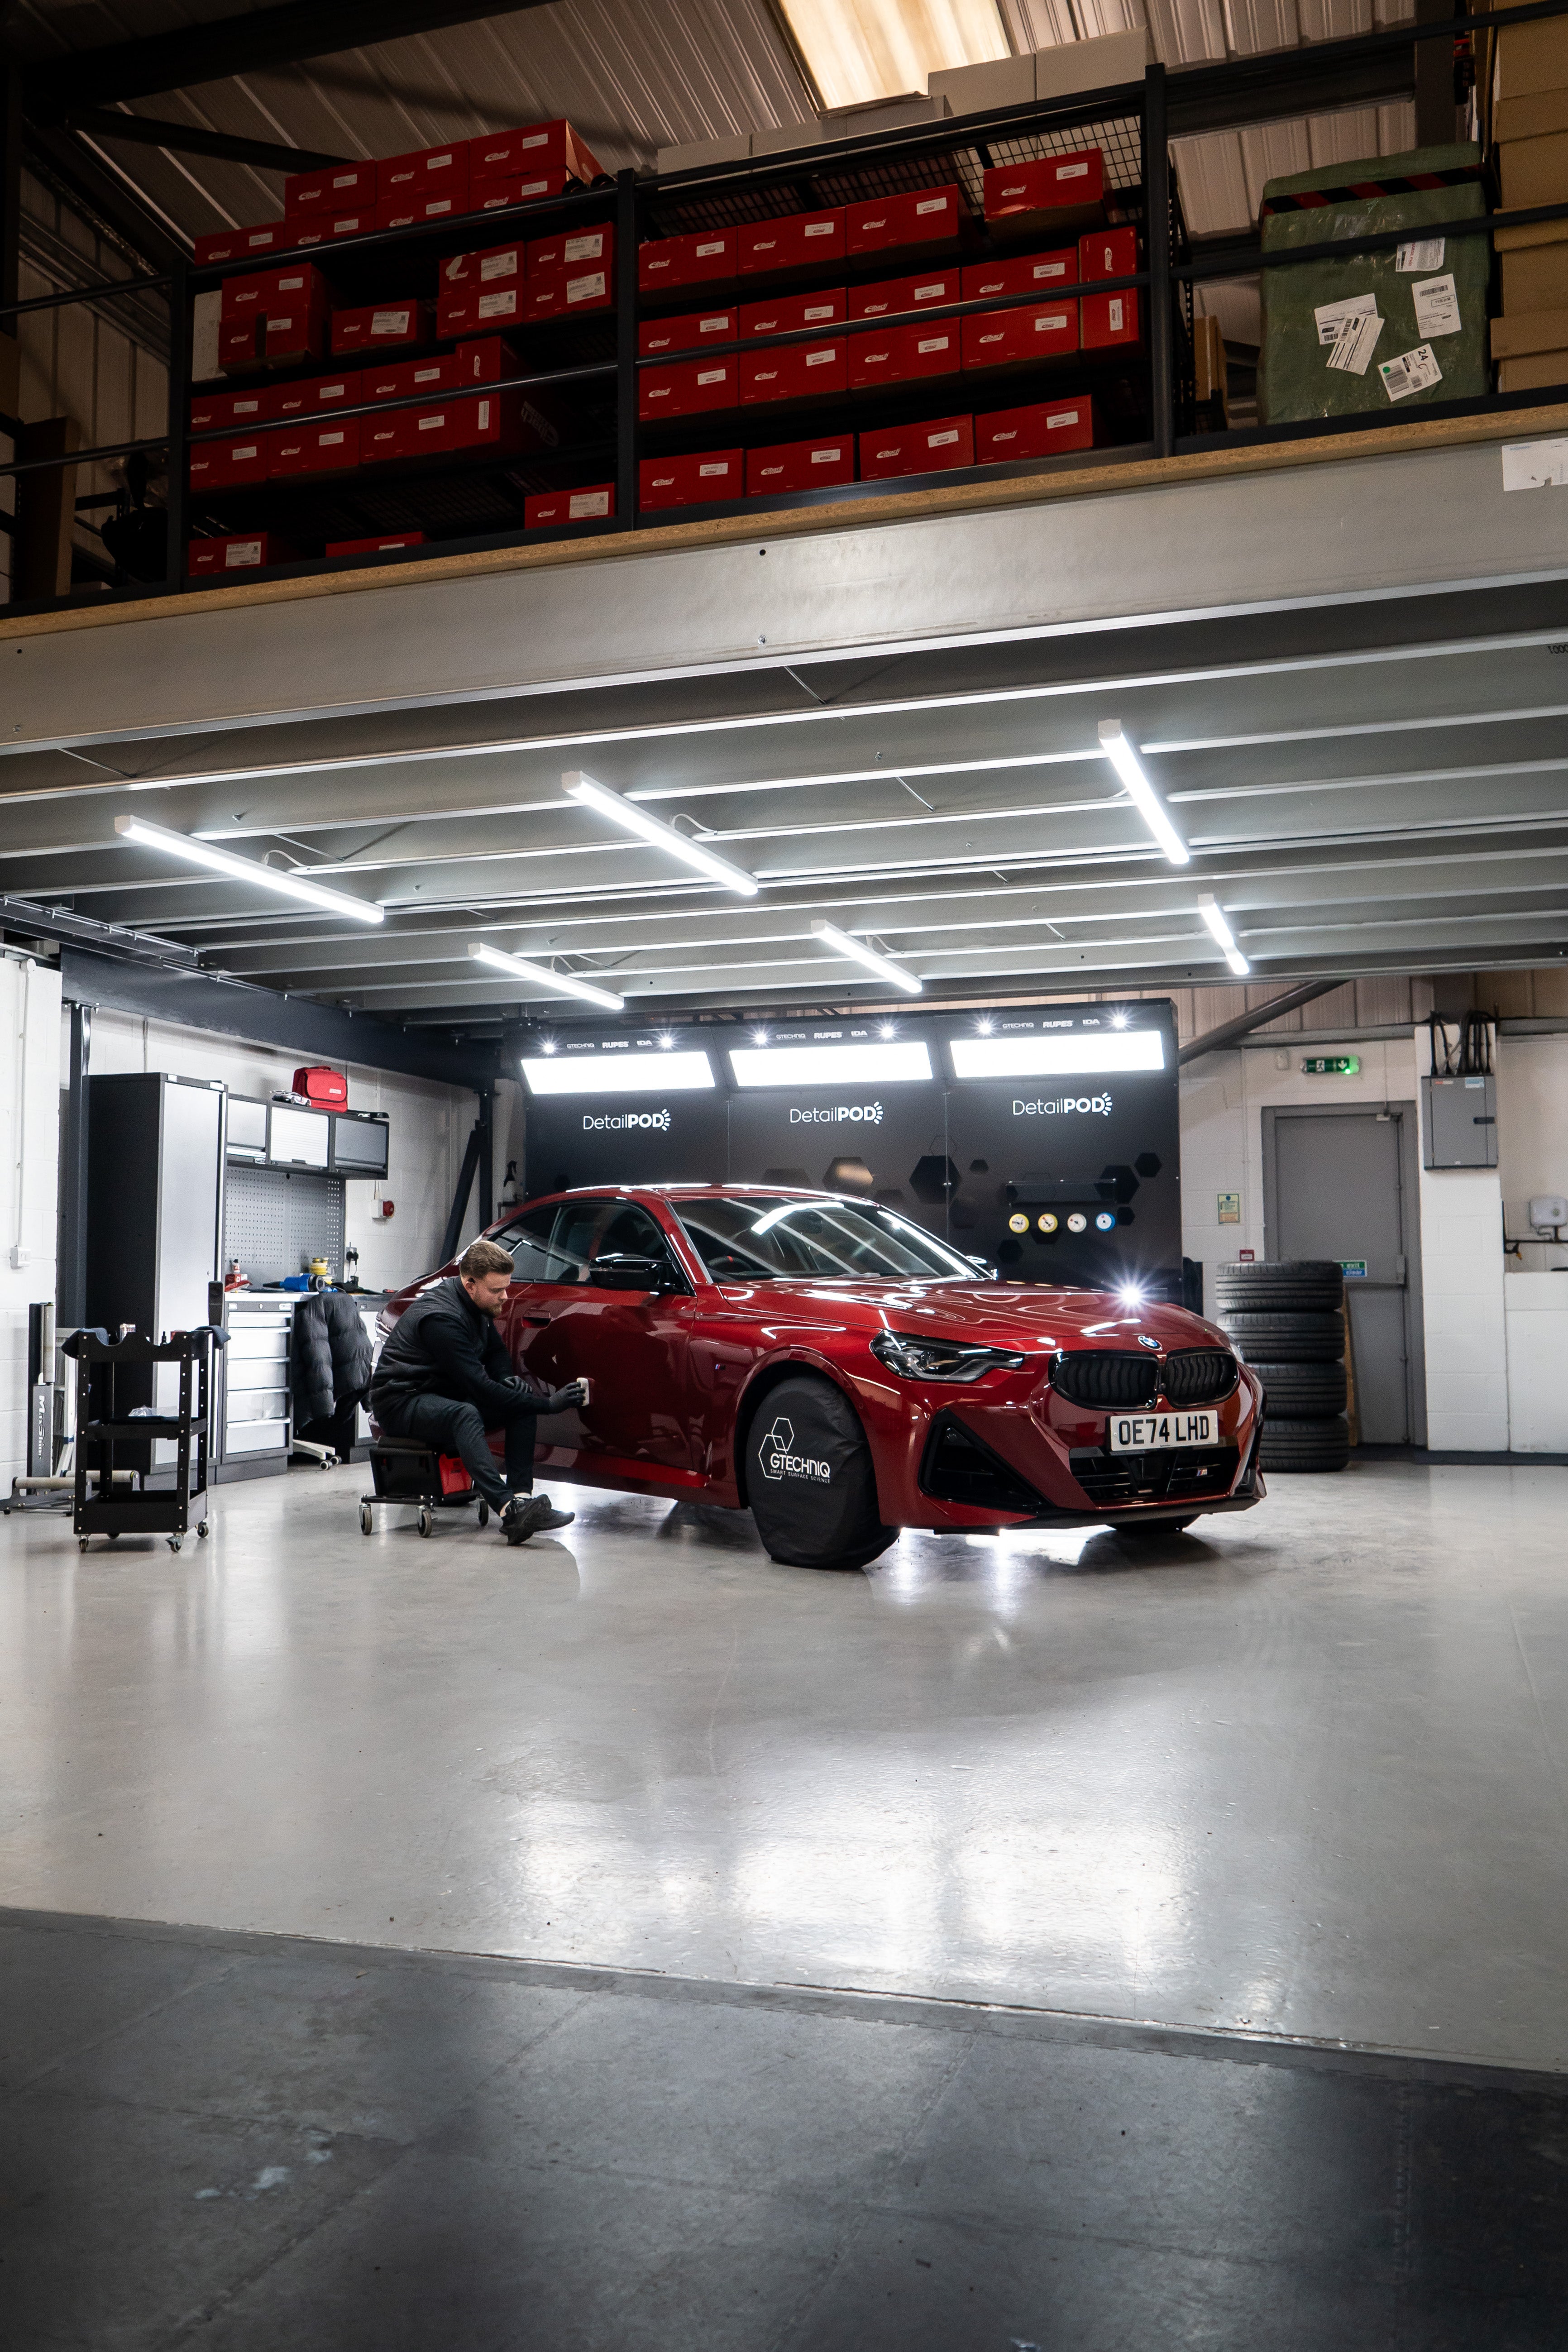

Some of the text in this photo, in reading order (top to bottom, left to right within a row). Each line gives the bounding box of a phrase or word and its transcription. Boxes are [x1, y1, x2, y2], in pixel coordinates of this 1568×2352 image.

[790, 1106, 876, 1123] DetailPOD
[1013, 1096, 1105, 1116] DetailPOD
[583, 1112, 664, 1130] DetailPOD
[1119, 1415, 1209, 1445] OE74 LHD
[770, 1453, 830, 1478] GTECHNIQ
